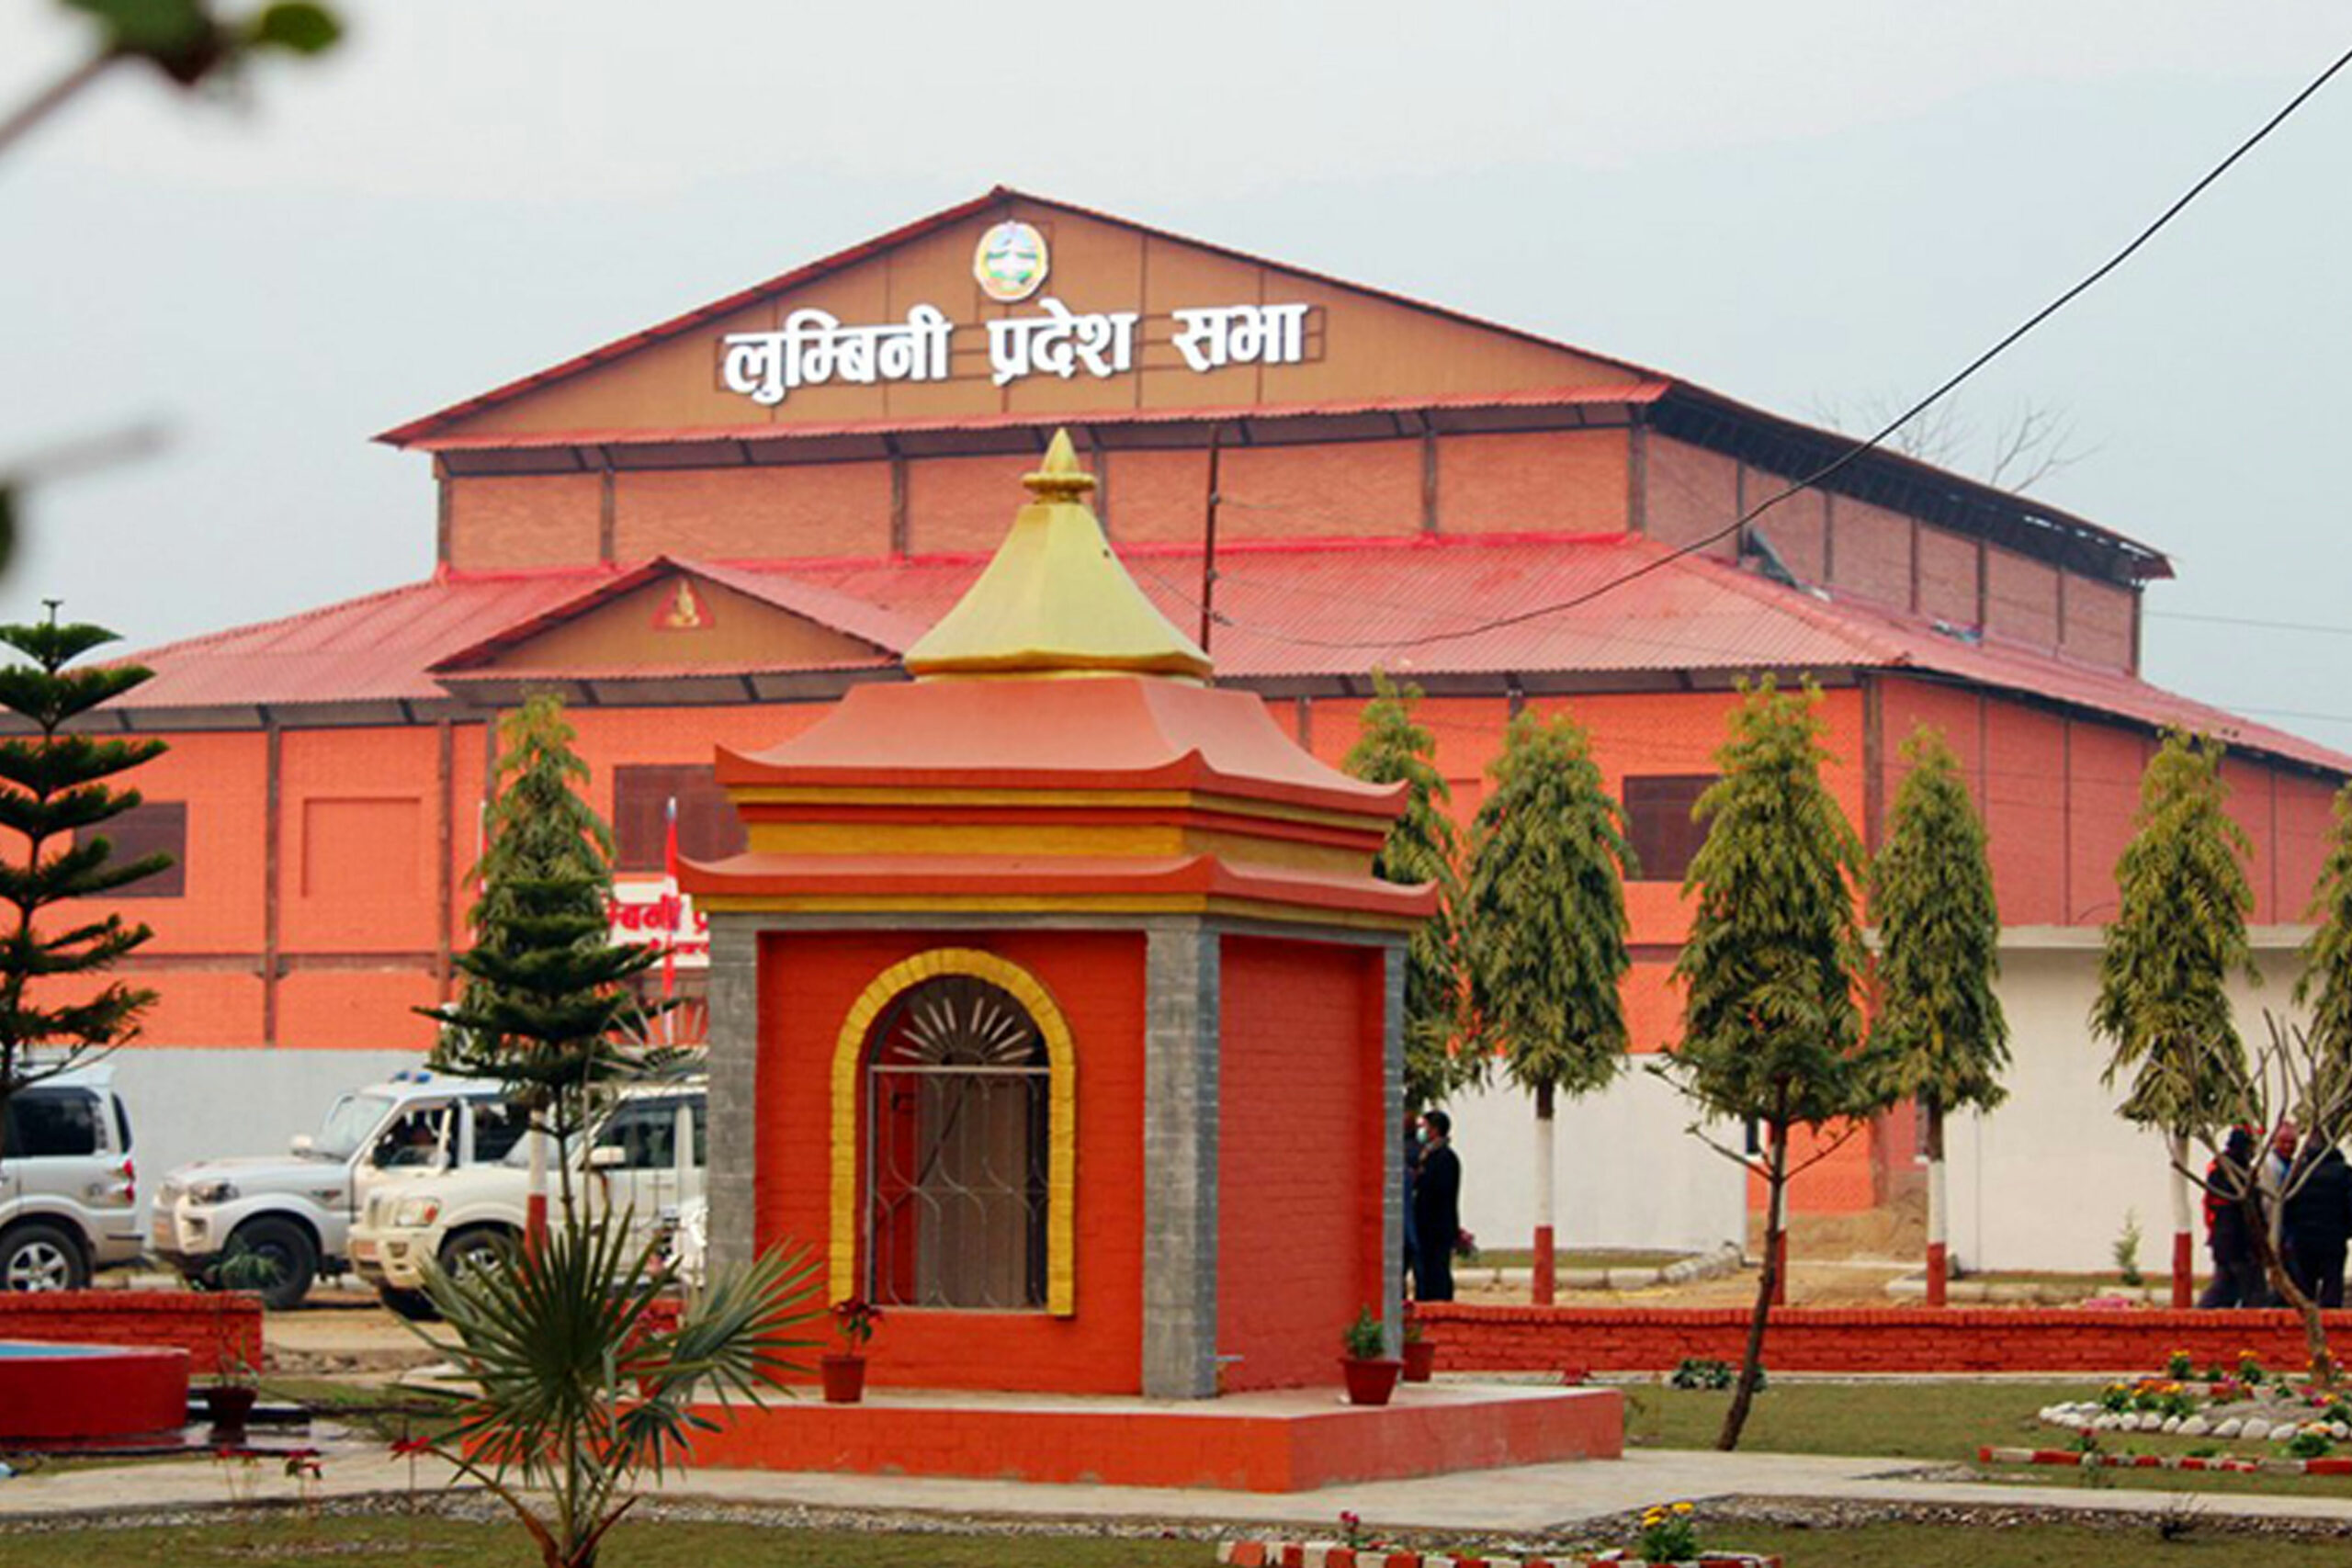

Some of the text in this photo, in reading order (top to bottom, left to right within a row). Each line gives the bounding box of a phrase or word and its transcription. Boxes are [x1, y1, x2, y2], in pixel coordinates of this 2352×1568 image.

[723, 297, 1307, 404] लुम्बिनी प्रदेश सभा
